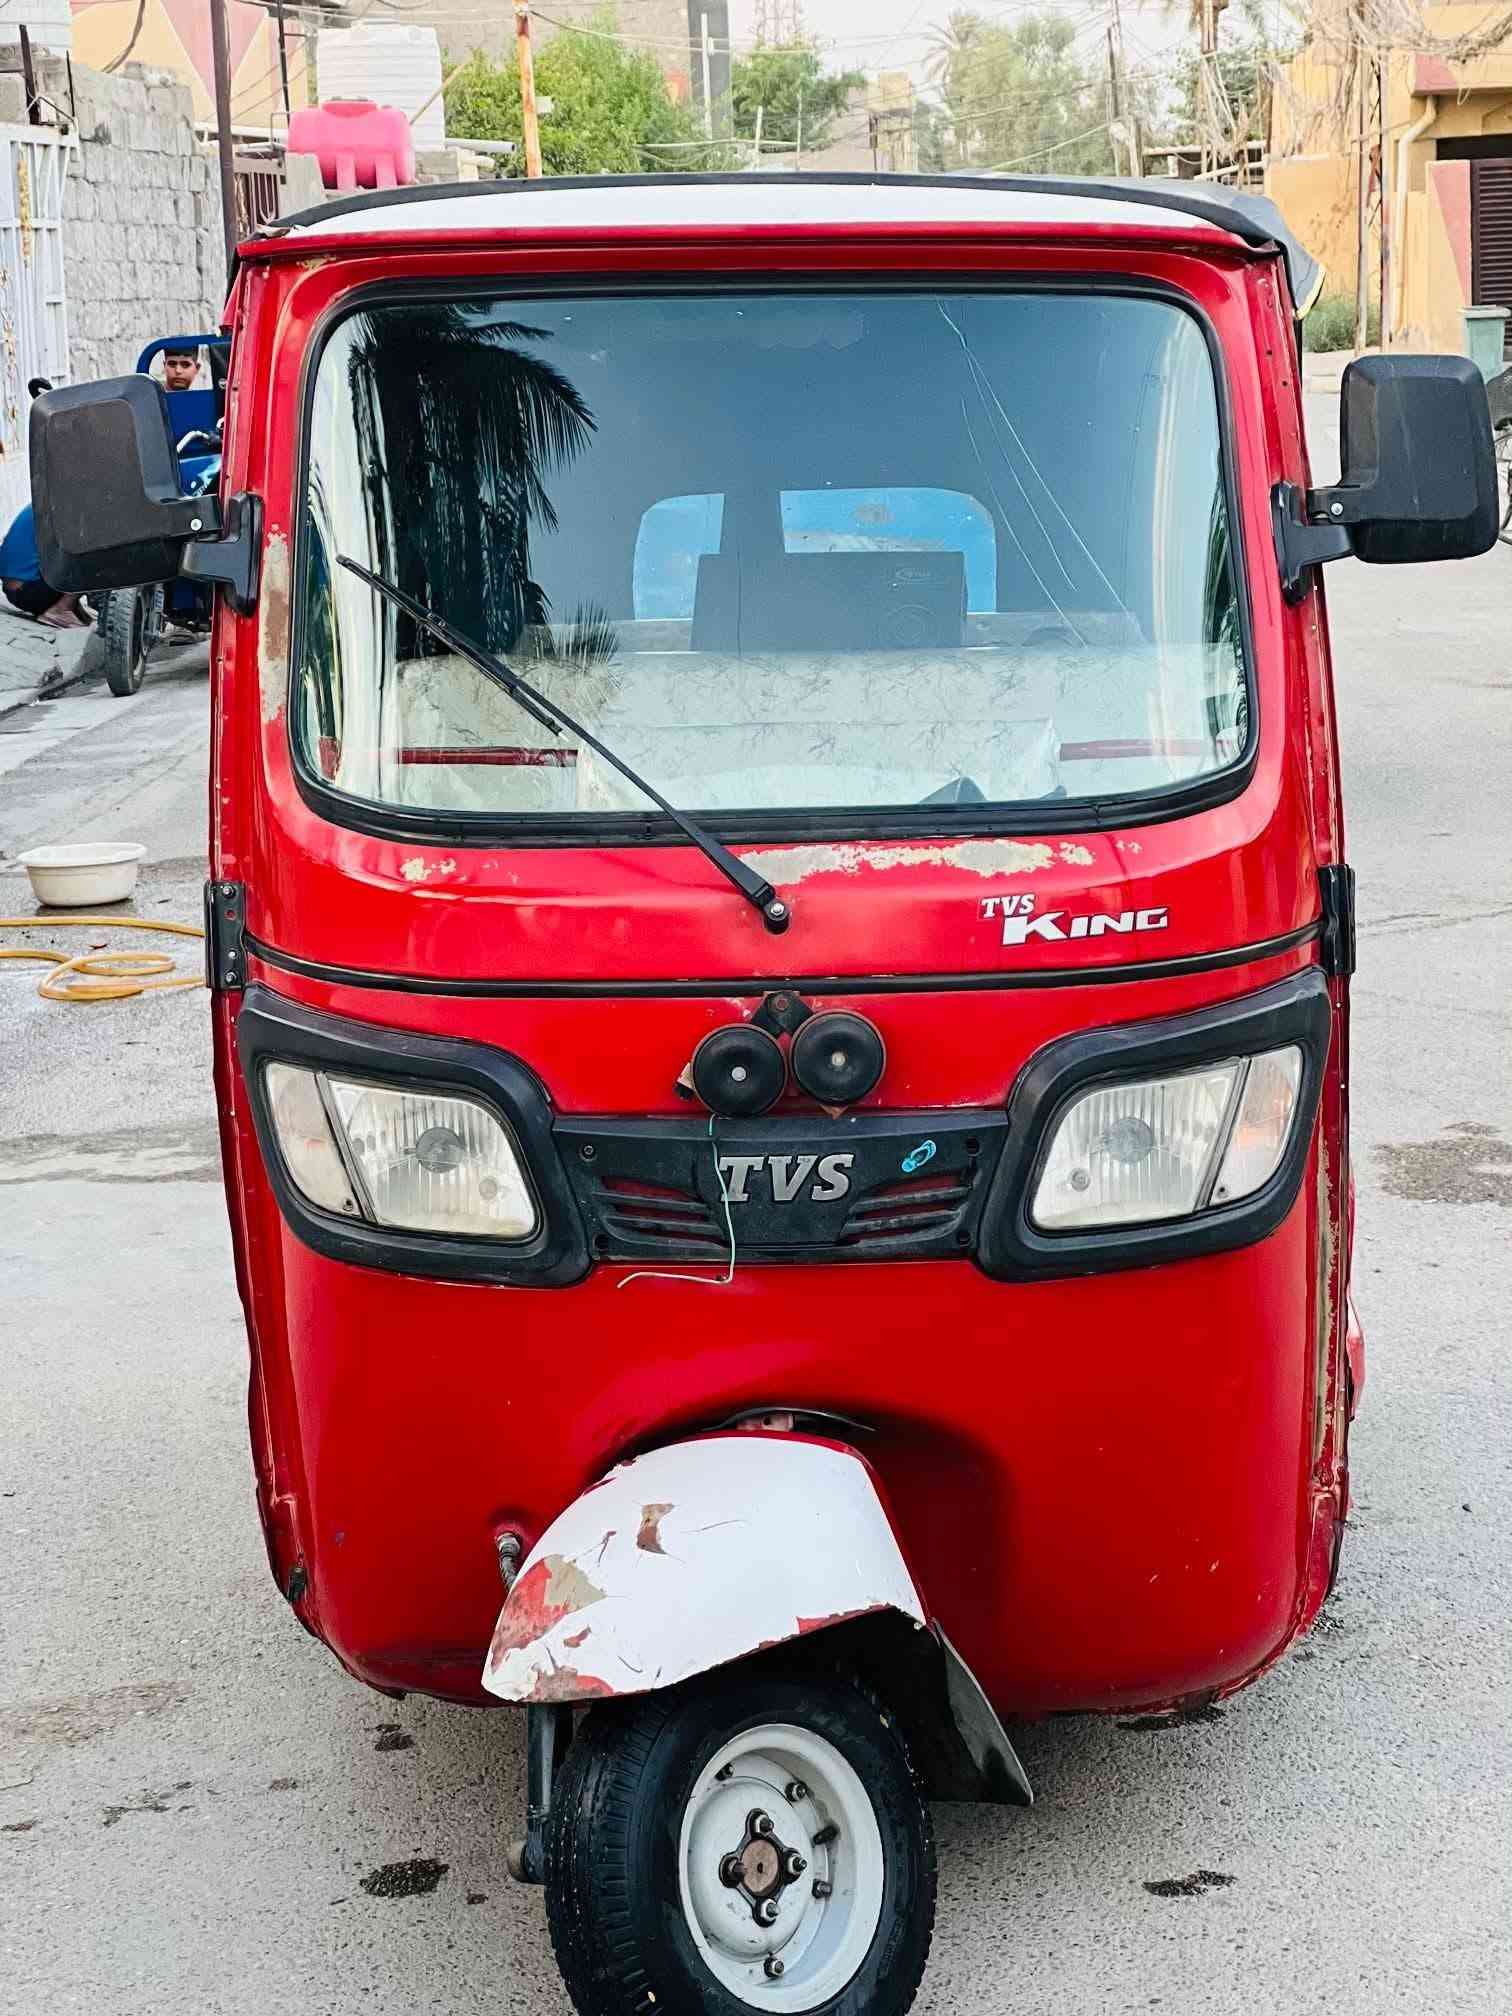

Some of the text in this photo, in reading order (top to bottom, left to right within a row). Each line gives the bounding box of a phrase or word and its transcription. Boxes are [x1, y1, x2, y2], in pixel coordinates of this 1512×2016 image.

[980, 893, 1035, 918] TVS
[1002, 907, 1168, 945] KING
[718, 1153, 854, 1202] TVS
